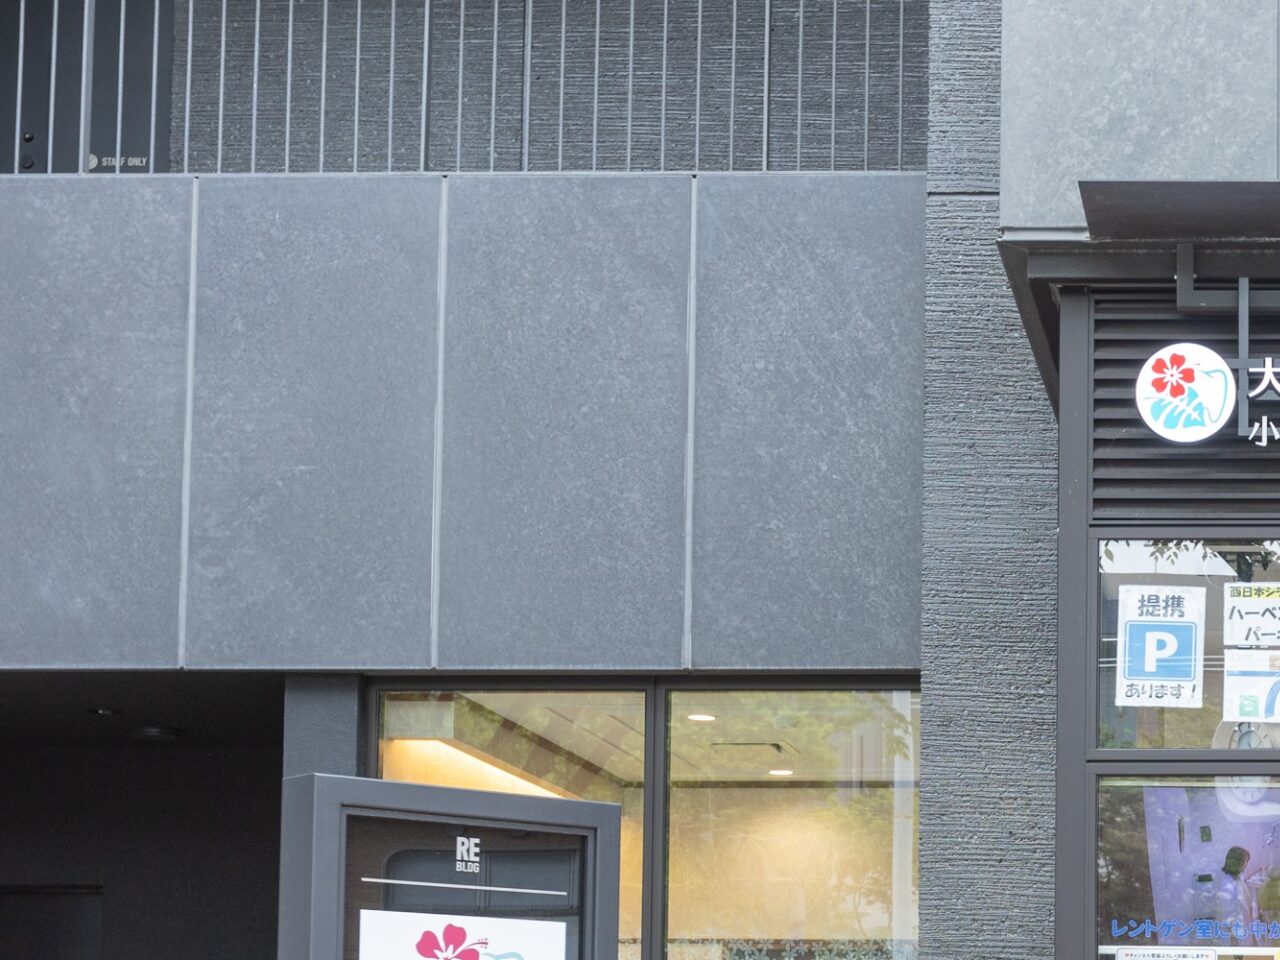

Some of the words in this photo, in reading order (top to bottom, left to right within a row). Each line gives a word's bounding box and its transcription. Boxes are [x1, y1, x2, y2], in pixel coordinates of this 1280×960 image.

[102, 157, 126, 166] STAF
[128, 157, 147, 166] ONLY
[1137, 594, 1185, 618] 提携
[1144, 631, 1178, 673] P
[456, 836, 480, 862] RE
[456, 861, 480, 873] BLDG
